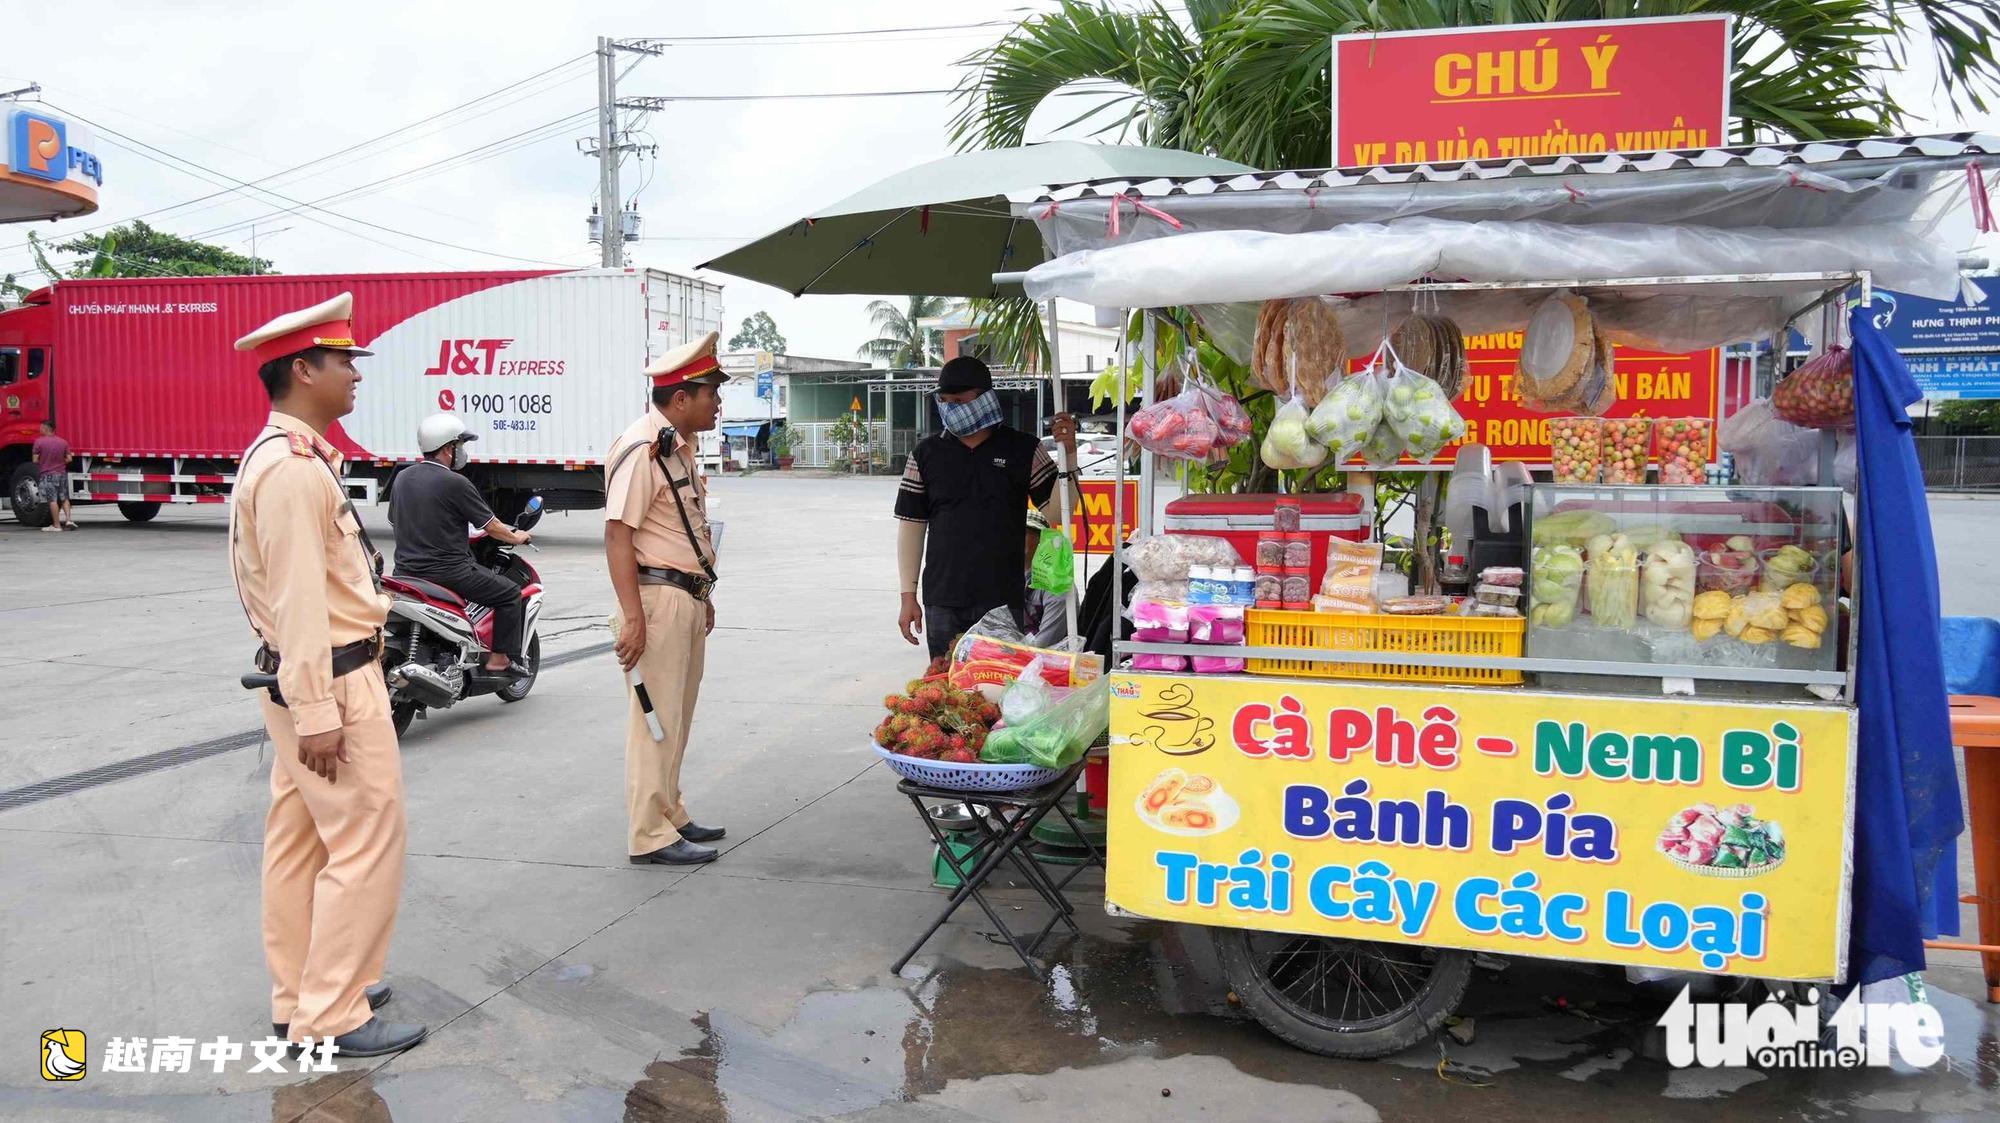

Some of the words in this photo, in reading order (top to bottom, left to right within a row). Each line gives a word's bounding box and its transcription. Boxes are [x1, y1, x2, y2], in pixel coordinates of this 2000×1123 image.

[1434, 38, 1558, 97] CHÚ
[1580, 34, 1619, 90] Ý
[178, 302, 218, 313] EXPRESS
[1911, 318, 1945, 328] HƯNG
[1948, 316, 1982, 328] THỊNH
[424, 338, 515, 376] J&T
[500, 360, 566, 376] EXPRESS
[1636, 366, 1691, 400] BÁN
[461, 394, 504, 414] 1900
[509, 394, 553, 414] 1088
[1486, 419, 1553, 446] RONG
[1233, 696, 1311, 758] Cà
[1329, 706, 1458, 768] Phê
[1535, 720, 1700, 782] Nem
[1722, 722, 1798, 789] Bì
[1284, 779, 1470, 849] Bánh
[1491, 793, 1616, 861] Pía
[1156, 849, 1291, 912] Trái
[1309, 860, 1437, 935] Cây
[1454, 871, 1585, 941] Các
[1605, 890, 1765, 969] Loại
